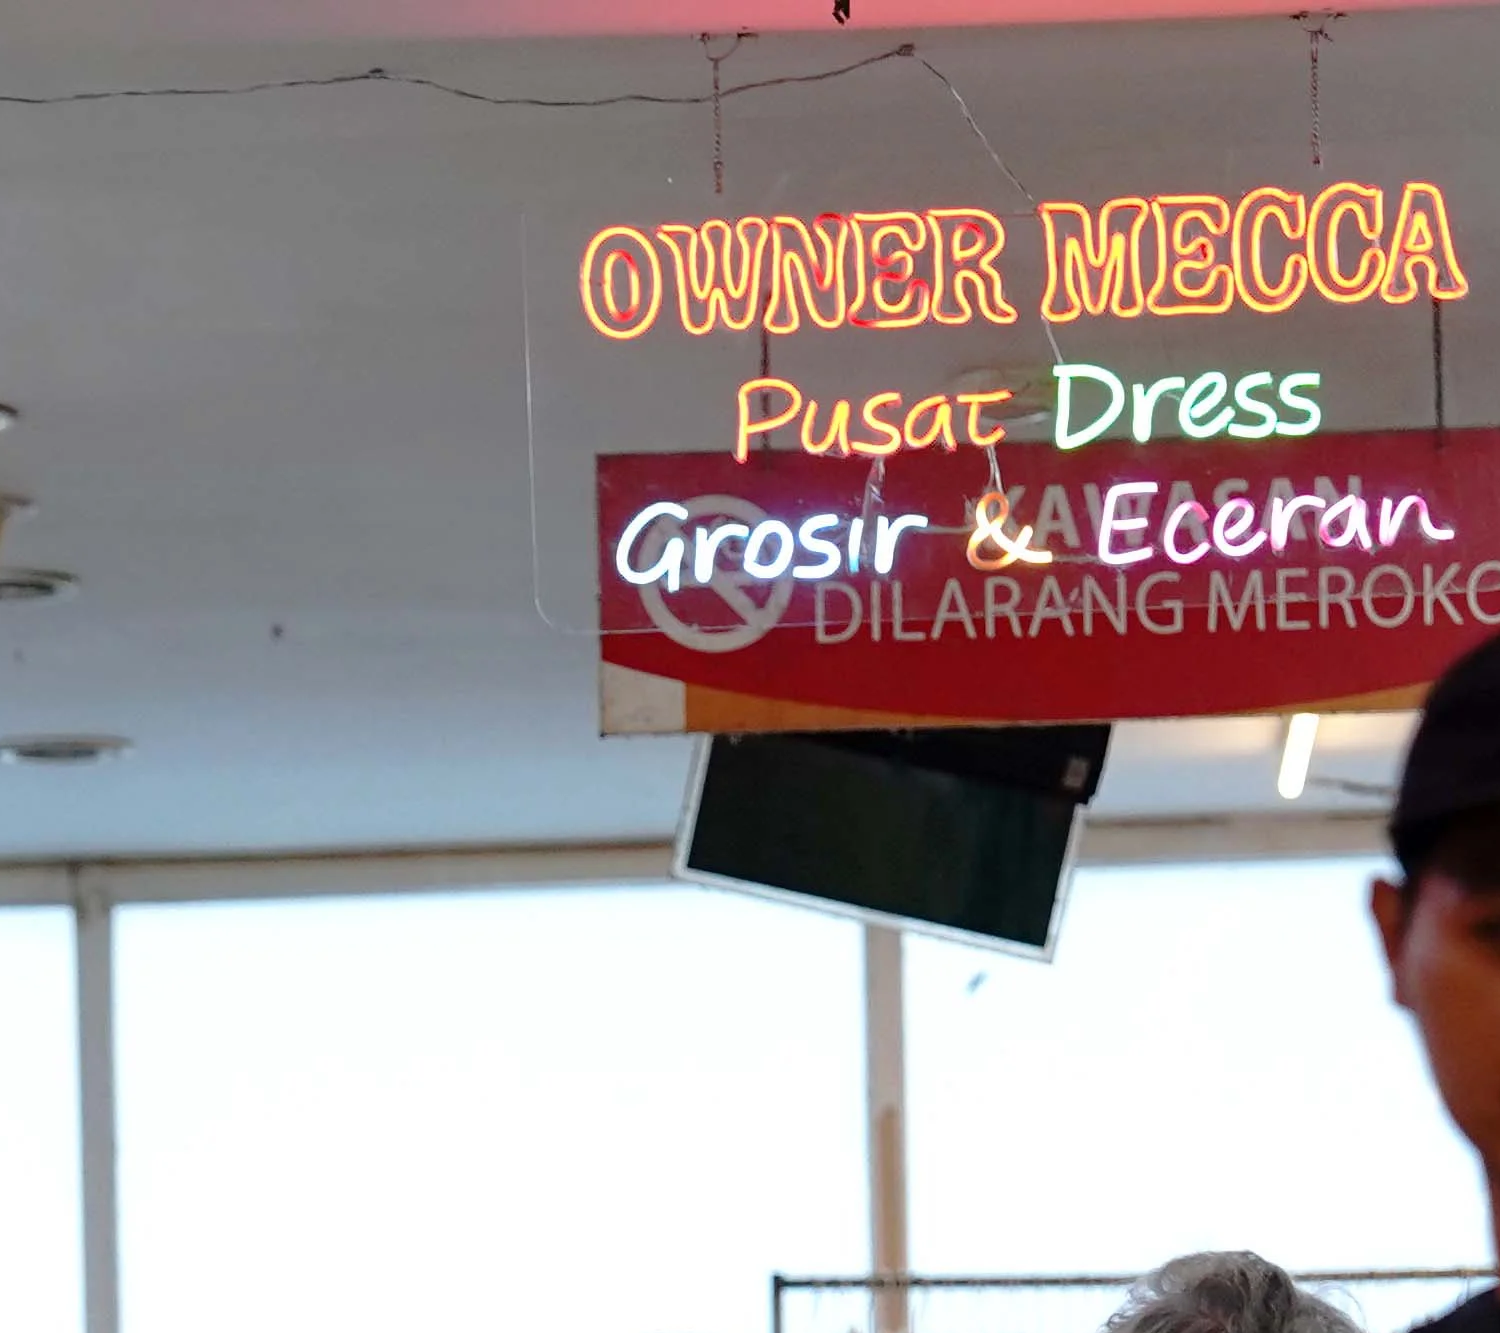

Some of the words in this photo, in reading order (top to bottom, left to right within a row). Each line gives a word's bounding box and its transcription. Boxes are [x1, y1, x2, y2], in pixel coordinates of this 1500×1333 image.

[580, 208, 1018, 340] OWNER
[1037, 181, 1470, 323] MECCA
[734, 377, 1014, 465] Pusat
[1052, 363, 1322, 450] Dress
[615, 500, 929, 593] Grosir
[966, 491, 1053, 571] &
[1097, 481, 1456, 566] Eceran
[814, 570, 1184, 644] DILARANG
